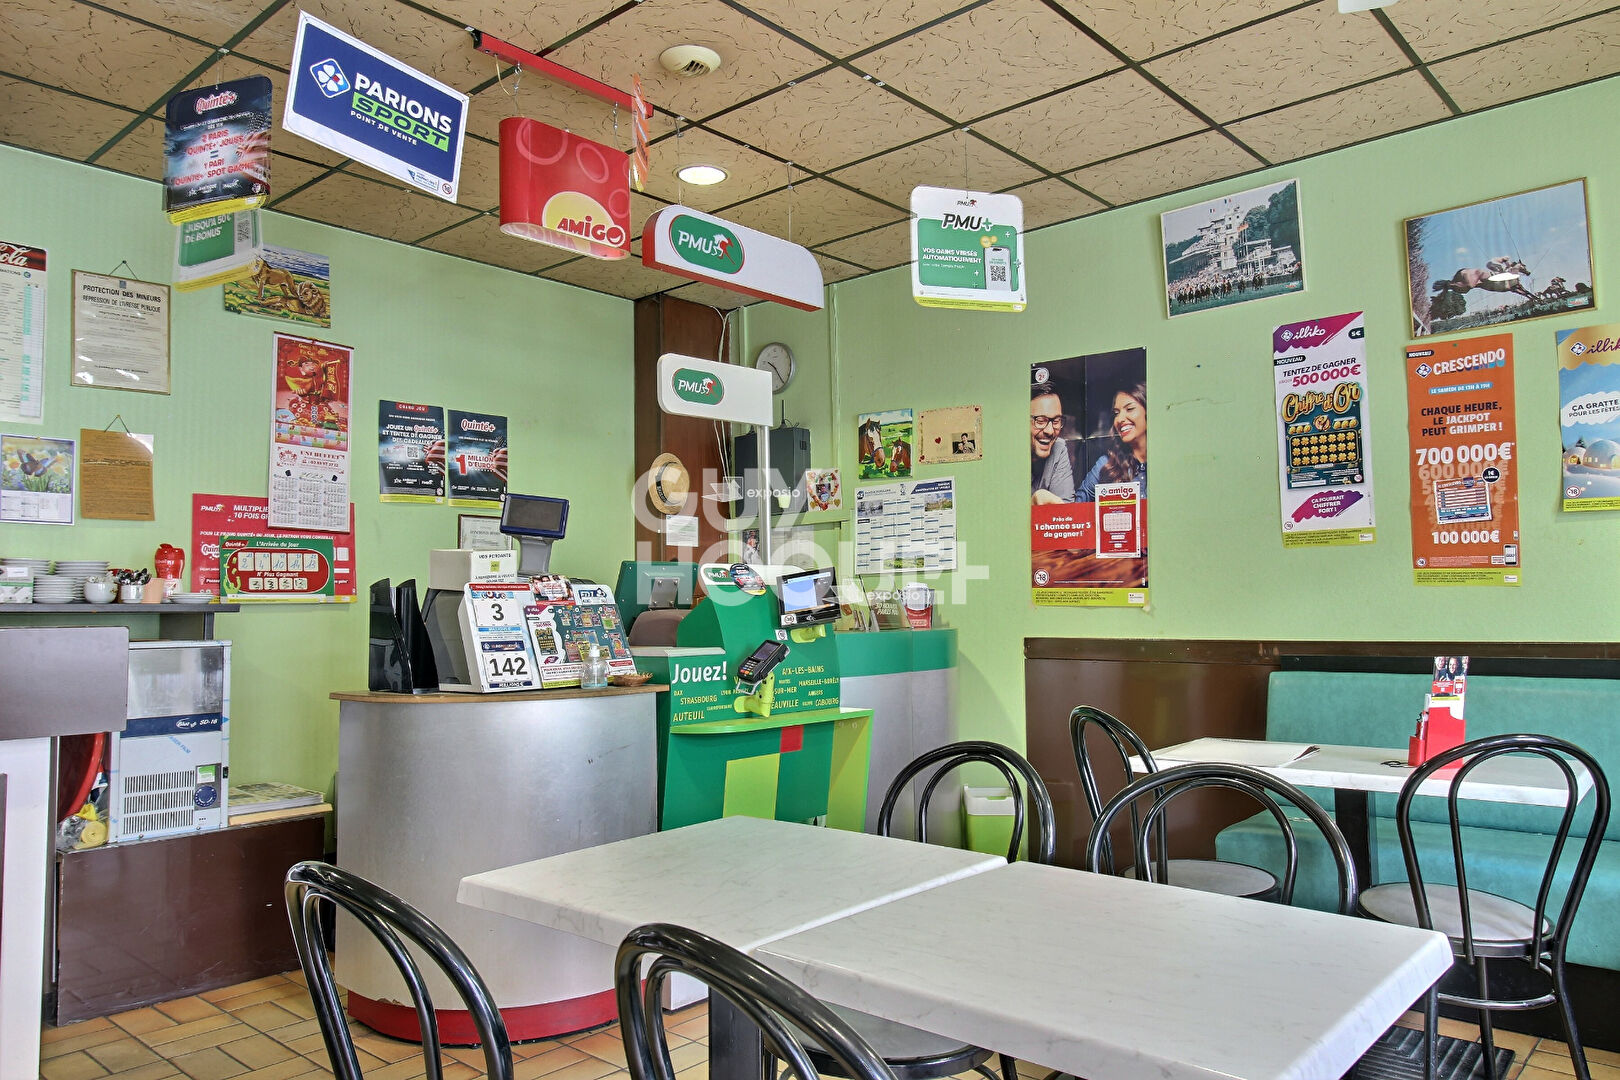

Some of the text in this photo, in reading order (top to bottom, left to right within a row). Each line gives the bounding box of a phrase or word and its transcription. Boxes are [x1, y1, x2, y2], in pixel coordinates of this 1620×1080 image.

[355, 72, 452, 134] PARIONS
[350, 110, 418, 146] POINT DE VENTE
[356, 97, 446, 146] SPORT
[207, 168, 226, 178] SPOT
[943, 213, 992, 230] PMU+
[678, 230, 713, 254] PMU
[922, 254, 982, 264] AUTOMATIQUEMENT
[82, 284, 161, 303] PROTECTION DES MINEURS
[82, 295, 110, 305] REPRESSION
[1293, 325, 1326, 340] illiko
[1408, 350, 1432, 358] NOUVEAU
[1433, 348, 1506, 375] CRESCENDO
[1283, 357, 1357, 377] TENTEZ DE GAGNER
[1292, 364, 1361, 387] 500 000€
[678, 379, 703, 394] PMU
[1421, 401, 1502, 416] CHAQUE HEURE,
[1571, 398, 1619, 412] ÇA GRATTE
[1433, 412, 1490, 425] LE JACKPOT
[1568, 409, 1588, 418] POUR
[1588, 408, 1601, 416] LES
[386, 423, 405, 431] JOUEZ
[461, 419, 496, 432] Quinté+
[1422, 421, 1503, 437] PEUT GRIMPER !
[389, 430, 410, 438] TENTEZ
[1415, 446, 1454, 466] 700
[455, 454, 467, 475] 1
[467, 455, 494, 463] MILLION
[467, 461, 496, 470] D'EUROS
[1108, 486, 1134, 498] amigo
[1040, 523, 1070, 531] chance
[1054, 531, 1079, 539] gagner
[1431, 529, 1500, 545] 100 000€
[490, 603, 505, 621] 3
[489, 656, 528, 677] 142
[671, 660, 727, 684] Jouez!
[782, 665, 825, 676] AIX-LES-BAINS
[680, 694, 718, 705] STRASBOURG
[771, 698, 799, 710] EAUVILLE
[815, 697, 839, 707] CABOURG
[672, 710, 705, 722] AUTEUIL
